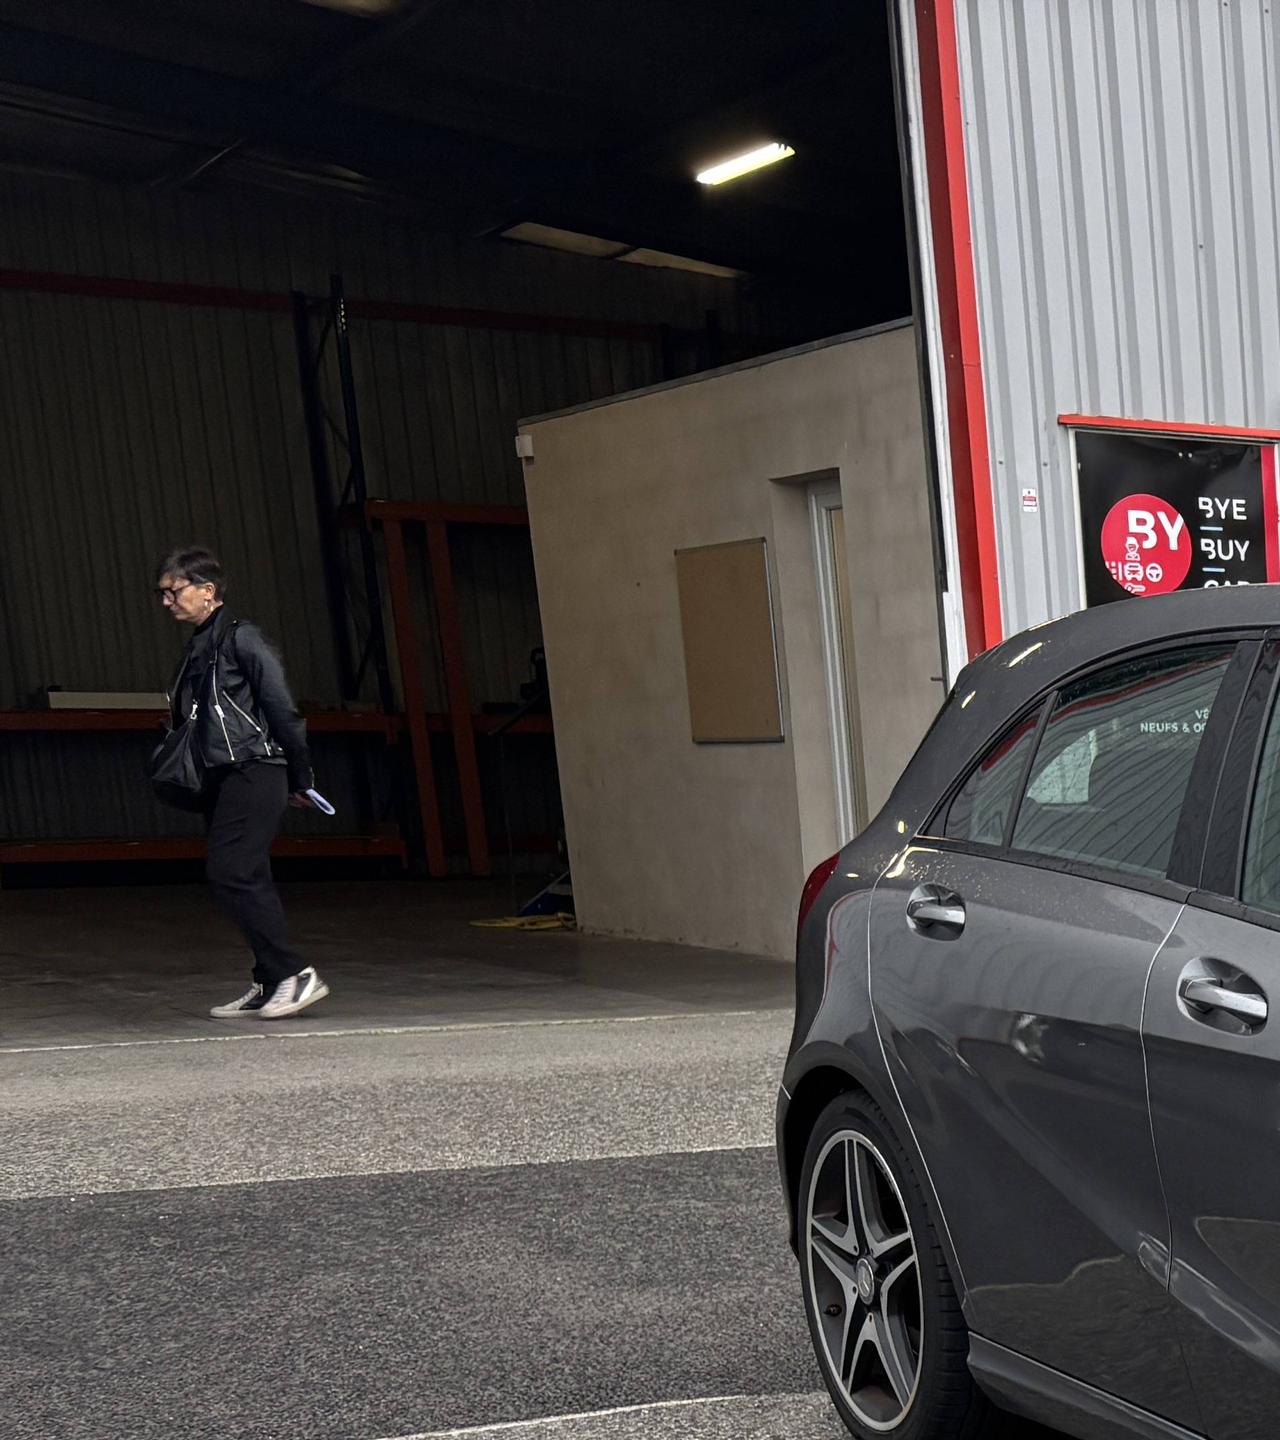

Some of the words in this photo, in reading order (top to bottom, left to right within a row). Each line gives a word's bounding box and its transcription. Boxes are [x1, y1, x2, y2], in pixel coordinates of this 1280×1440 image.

[1198, 496, 1248, 521] BYE
[1127, 509, 1185, 551] BY
[1200, 538, 1250, 562] BUY
[1140, 722, 1178, 733] NEUFS
[1183, 722, 1190, 733] &
